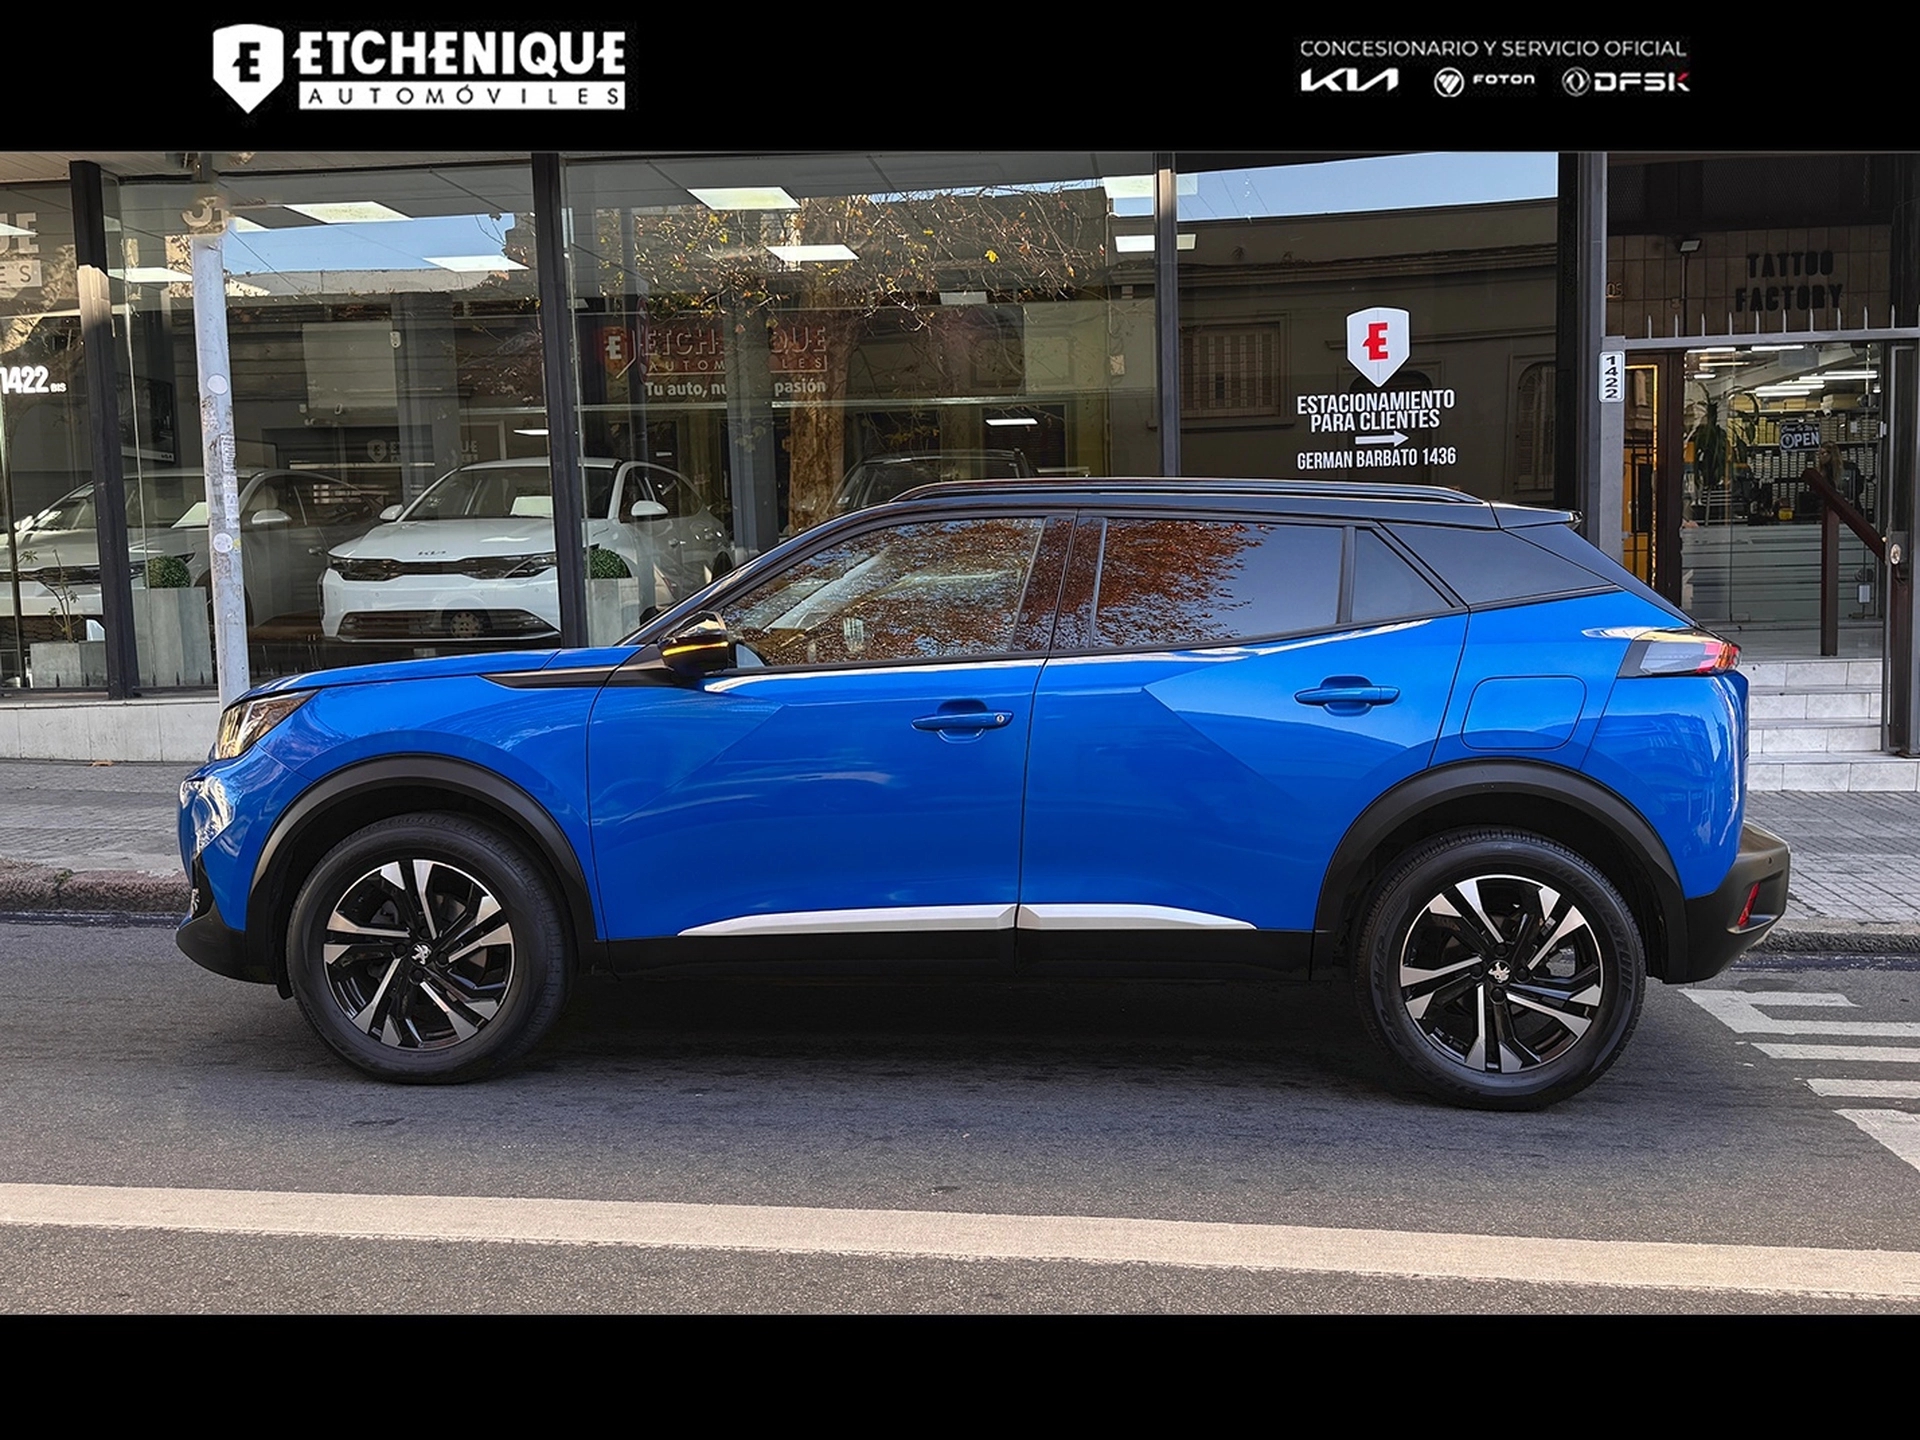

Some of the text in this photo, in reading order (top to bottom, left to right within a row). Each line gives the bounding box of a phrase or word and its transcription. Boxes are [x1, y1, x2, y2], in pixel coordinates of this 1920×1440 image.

[1748, 251, 1834, 278] TATTOO
[1735, 284, 1843, 313] FACTORY
[667, 381, 708, 398] auto,
[774, 378, 827, 397] pasión
[1605, 355, 1618, 399] 1422
[1297, 389, 1455, 414] ESTACIONAMIENTO
[1311, 409, 1441, 433] PARA CLIENTES
[1780, 432, 1820, 449] OPEN
[1297, 447, 1457, 470] GERMAN BARBATO 1436
